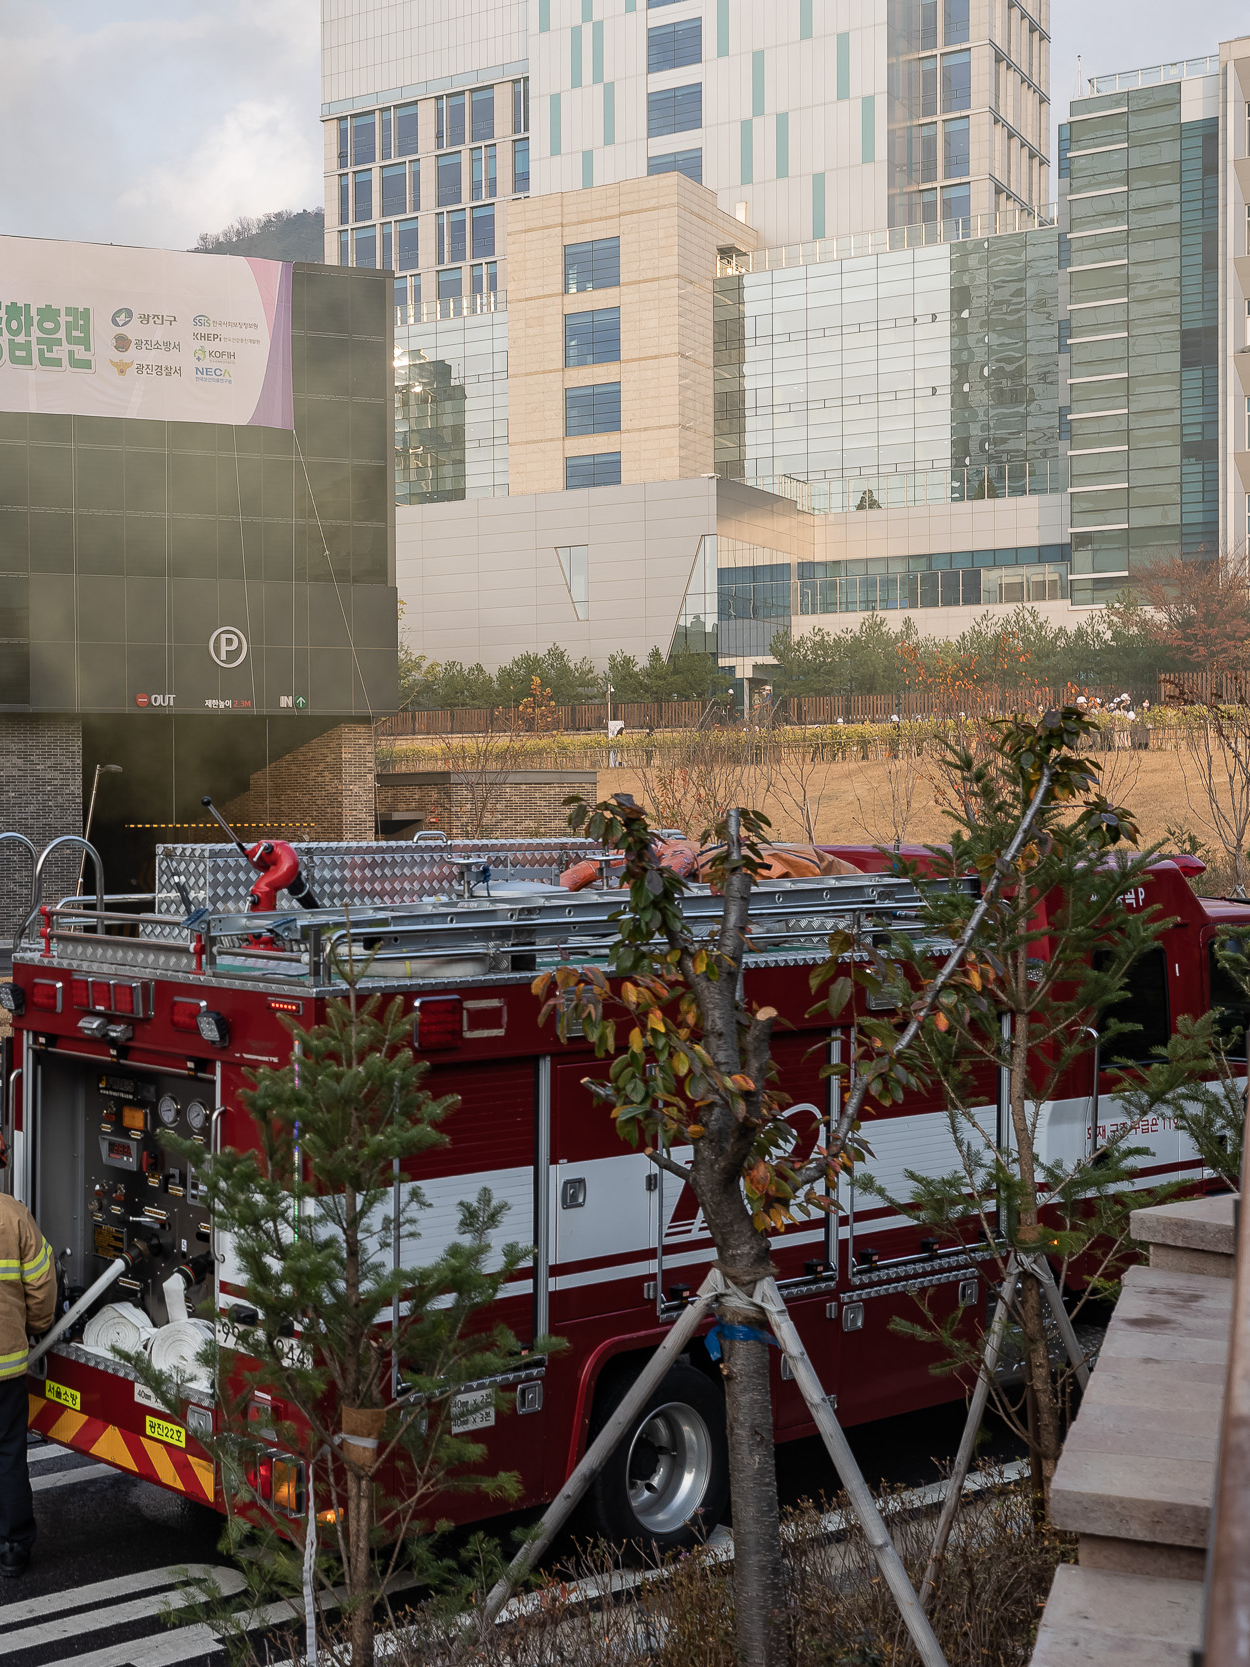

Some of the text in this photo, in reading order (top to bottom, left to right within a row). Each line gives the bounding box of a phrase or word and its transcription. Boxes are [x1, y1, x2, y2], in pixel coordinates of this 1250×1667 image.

[137, 313, 178, 326] 광진구
[134, 338, 181, 352] 광진소방서
[208, 350, 236, 360] KOFIH
[135, 363, 182, 377] 광진경찰서
[151, 694, 176, 706] OUT
[204, 699, 251, 709] 제한높이 2.3M
[279, 695, 292, 707] IN
[47, 1382, 78, 1407] 서울소방
[148, 1419, 184, 1443] 광진22호
